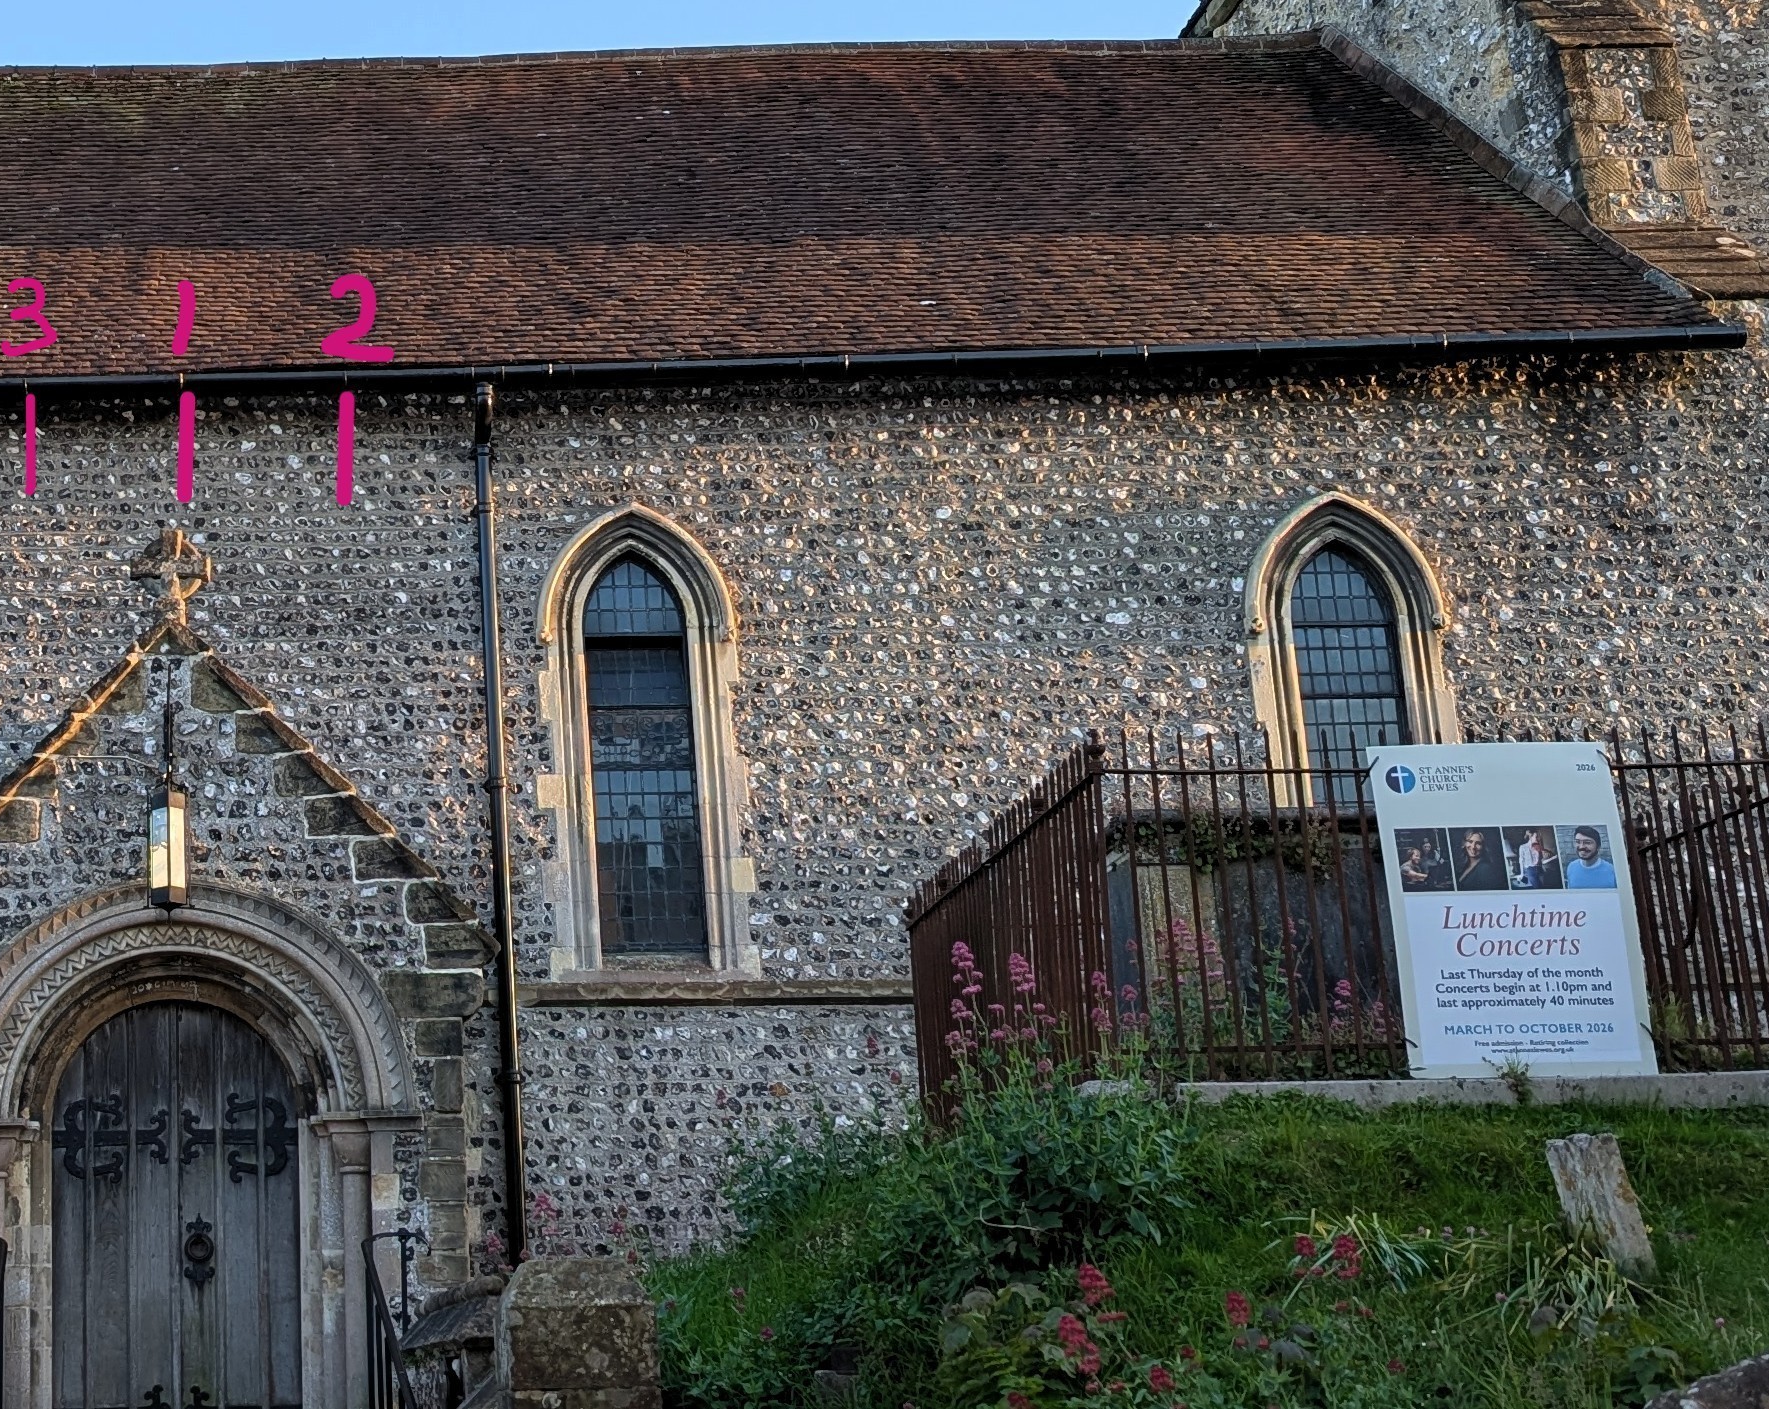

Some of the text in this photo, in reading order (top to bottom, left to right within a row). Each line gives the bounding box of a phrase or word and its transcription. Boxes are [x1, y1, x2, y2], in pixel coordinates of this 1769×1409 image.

[1418, 765, 1474, 775] ST ANNE'S
[1575, 763, 1596, 772] 2026
[1420, 774, 1467, 784] CHURCH
[1421, 783, 1459, 792] LEWES
[1442, 904, 1587, 929] Lunchtime
[1456, 932, 1581, 958] Concerts
[1440, 967, 1604, 981] Last Thursday of the month
[1435, 981, 1612, 995] Concerts begin at 1.10pm and
[1437, 995, 1615, 1010] last approximately 40 minutes
[1444, 1023, 1614, 1035] MARCH TO OCTOBER 2026
